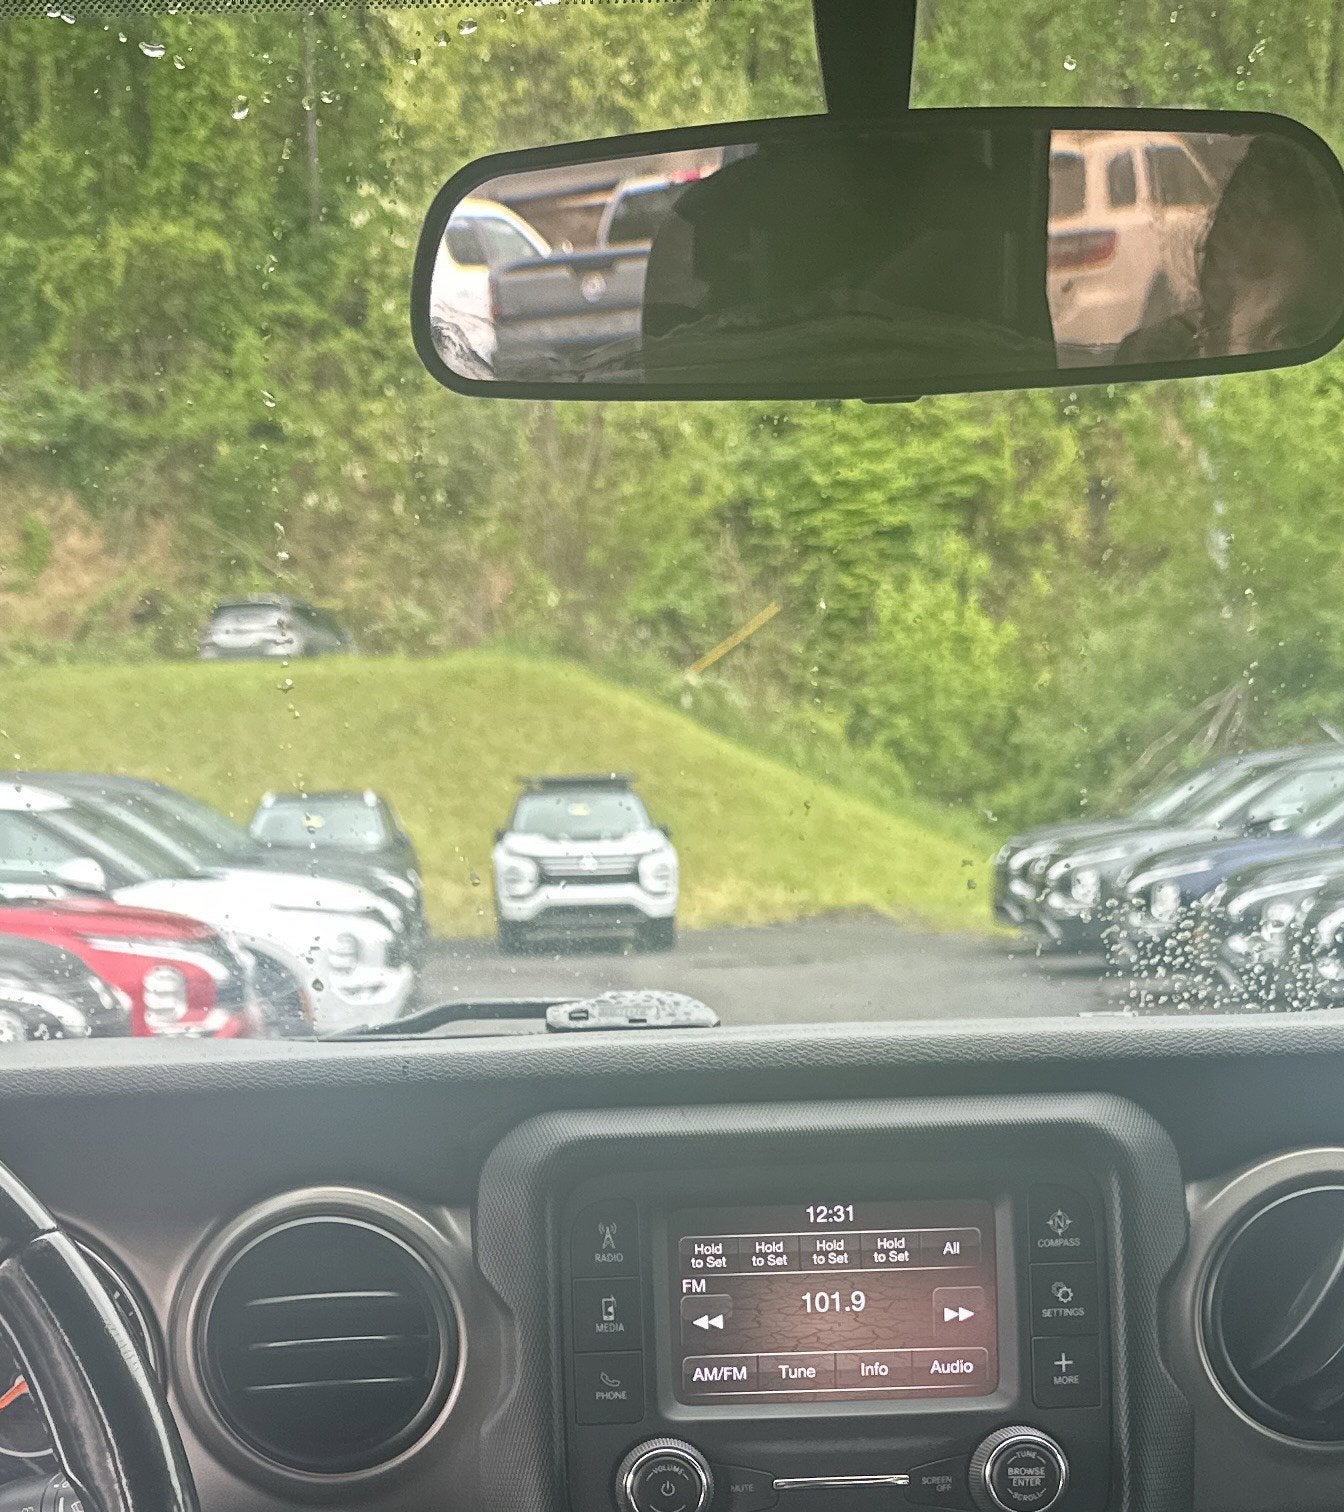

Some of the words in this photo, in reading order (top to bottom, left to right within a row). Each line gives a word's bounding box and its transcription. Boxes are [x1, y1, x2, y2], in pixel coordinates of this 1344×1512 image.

[805, 1205, 854, 1223] 12:31
[694, 1243, 723, 1255] Hold
[755, 1241, 784, 1253] Hold
[816, 1239, 844, 1251] Hold
[877, 1237, 905, 1249] Hold
[943, 1242, 960, 1255] All
[1037, 1238, 1081, 1248] COMPASS
[594, 1253, 624, 1263] RADIO
[691, 1257, 703, 1268] to
[706, 1256, 727, 1268] Set
[752, 1256, 765, 1267] to
[767, 1255, 787, 1266] Set
[812, 1254, 825, 1264] to
[827, 1253, 849, 1264] Set
[873, 1252, 886, 1262] to
[888, 1250, 909, 1262] Set
[682, 1279, 706, 1293] FM
[802, 1291, 865, 1313] 101.9
[1041, 1307, 1085, 1318] SETTINGS
[595, 1323, 624, 1333] MEDIA
[692, 1366, 747, 1382] AM/FM
[778, 1365, 816, 1379] Tune
[860, 1362, 889, 1376] Info
[930, 1360, 974, 1375] Audio
[1053, 1375, 1079, 1385] MORE
[595, 1391, 627, 1401] PHONE
[1016, 1450, 1038, 1459] TUNE
[652, 1465, 684, 1475] VOLUME
[1008, 1467, 1045, 1476] BROWSE
[921, 1476, 952, 1485] SCREEN
[1012, 1478, 1042, 1487] ENTER
[730, 1484, 755, 1493] MUTE
[936, 1484, 952, 1493] OFF
[1012, 1491, 1043, 1501] SCROLL
